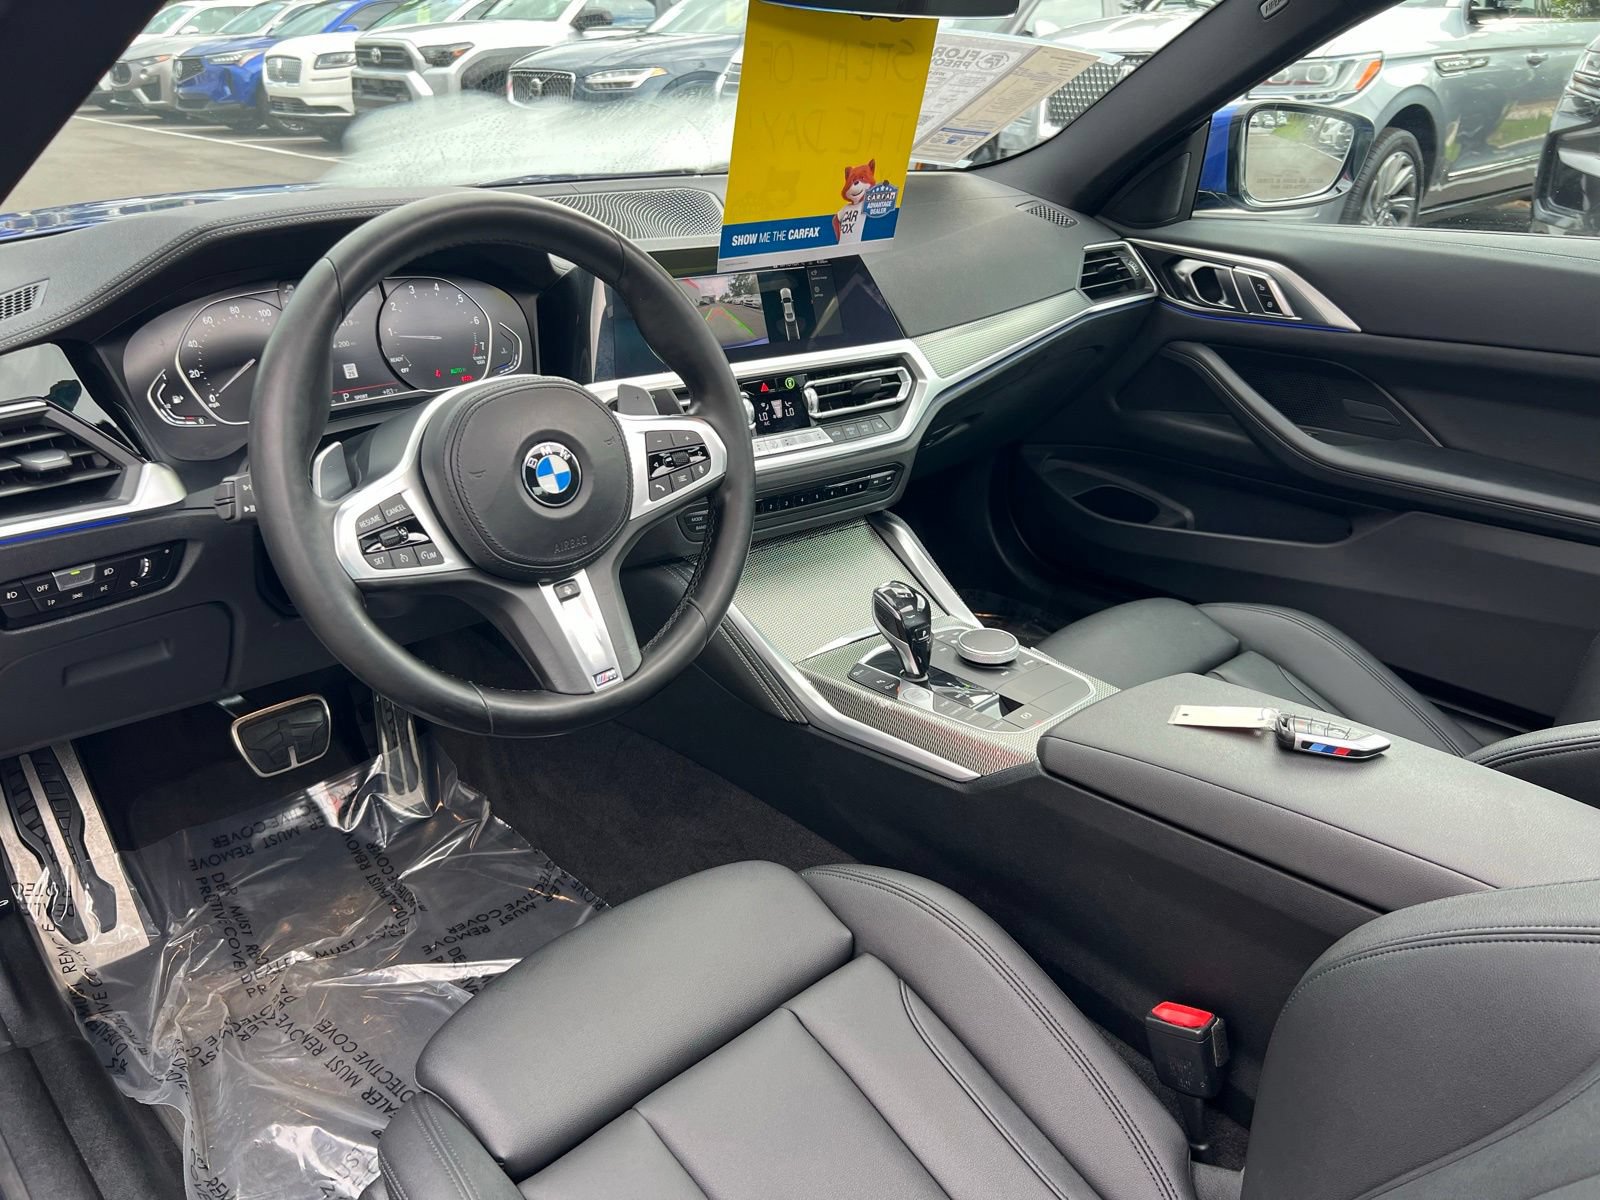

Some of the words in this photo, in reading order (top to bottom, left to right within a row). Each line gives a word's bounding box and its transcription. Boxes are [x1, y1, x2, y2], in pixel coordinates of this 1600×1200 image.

[731, 233, 758, 247] SHOW
[758, 231, 772, 243] ME
[772, 230, 787, 242] THE
[787, 226, 821, 240] CARFAX
[408, 285, 416, 294] 3
[433, 283, 440, 292] 4
[457, 294, 464, 303] 5
[229, 305, 240, 315] 80
[259, 308, 272, 318] 100
[390, 302, 397, 311] 2
[473, 316, 480, 325] 6
[187, 340, 198, 348] 40
[479, 341, 485, 351] 7
[188, 369, 201, 379] 20
[208, 394, 216, 402] 0
[342, 393, 350, 402] P
[526, 445, 571, 469] BMW
[385, 504, 407, 517] CANCEL
[359, 513, 381, 528] RESUME
[553, 535, 588, 554] AIRBAG
[373, 556, 385, 566] SET
[36, 583, 49, 593] OFF
[210, 820, 267, 849] COVER
[263, 826, 300, 849] MUST
[188, 842, 255, 872] REMOVE
[341, 830, 372, 871] REMOV
[500, 901, 537, 927] MUST
[446, 909, 502, 934] COVER
[421, 924, 492, 956] REMOVE
[313, 1018, 358, 1054] COVER
[323, 1055, 364, 1089] MUST
[352, 1051, 417, 1104] OTECTIVE
